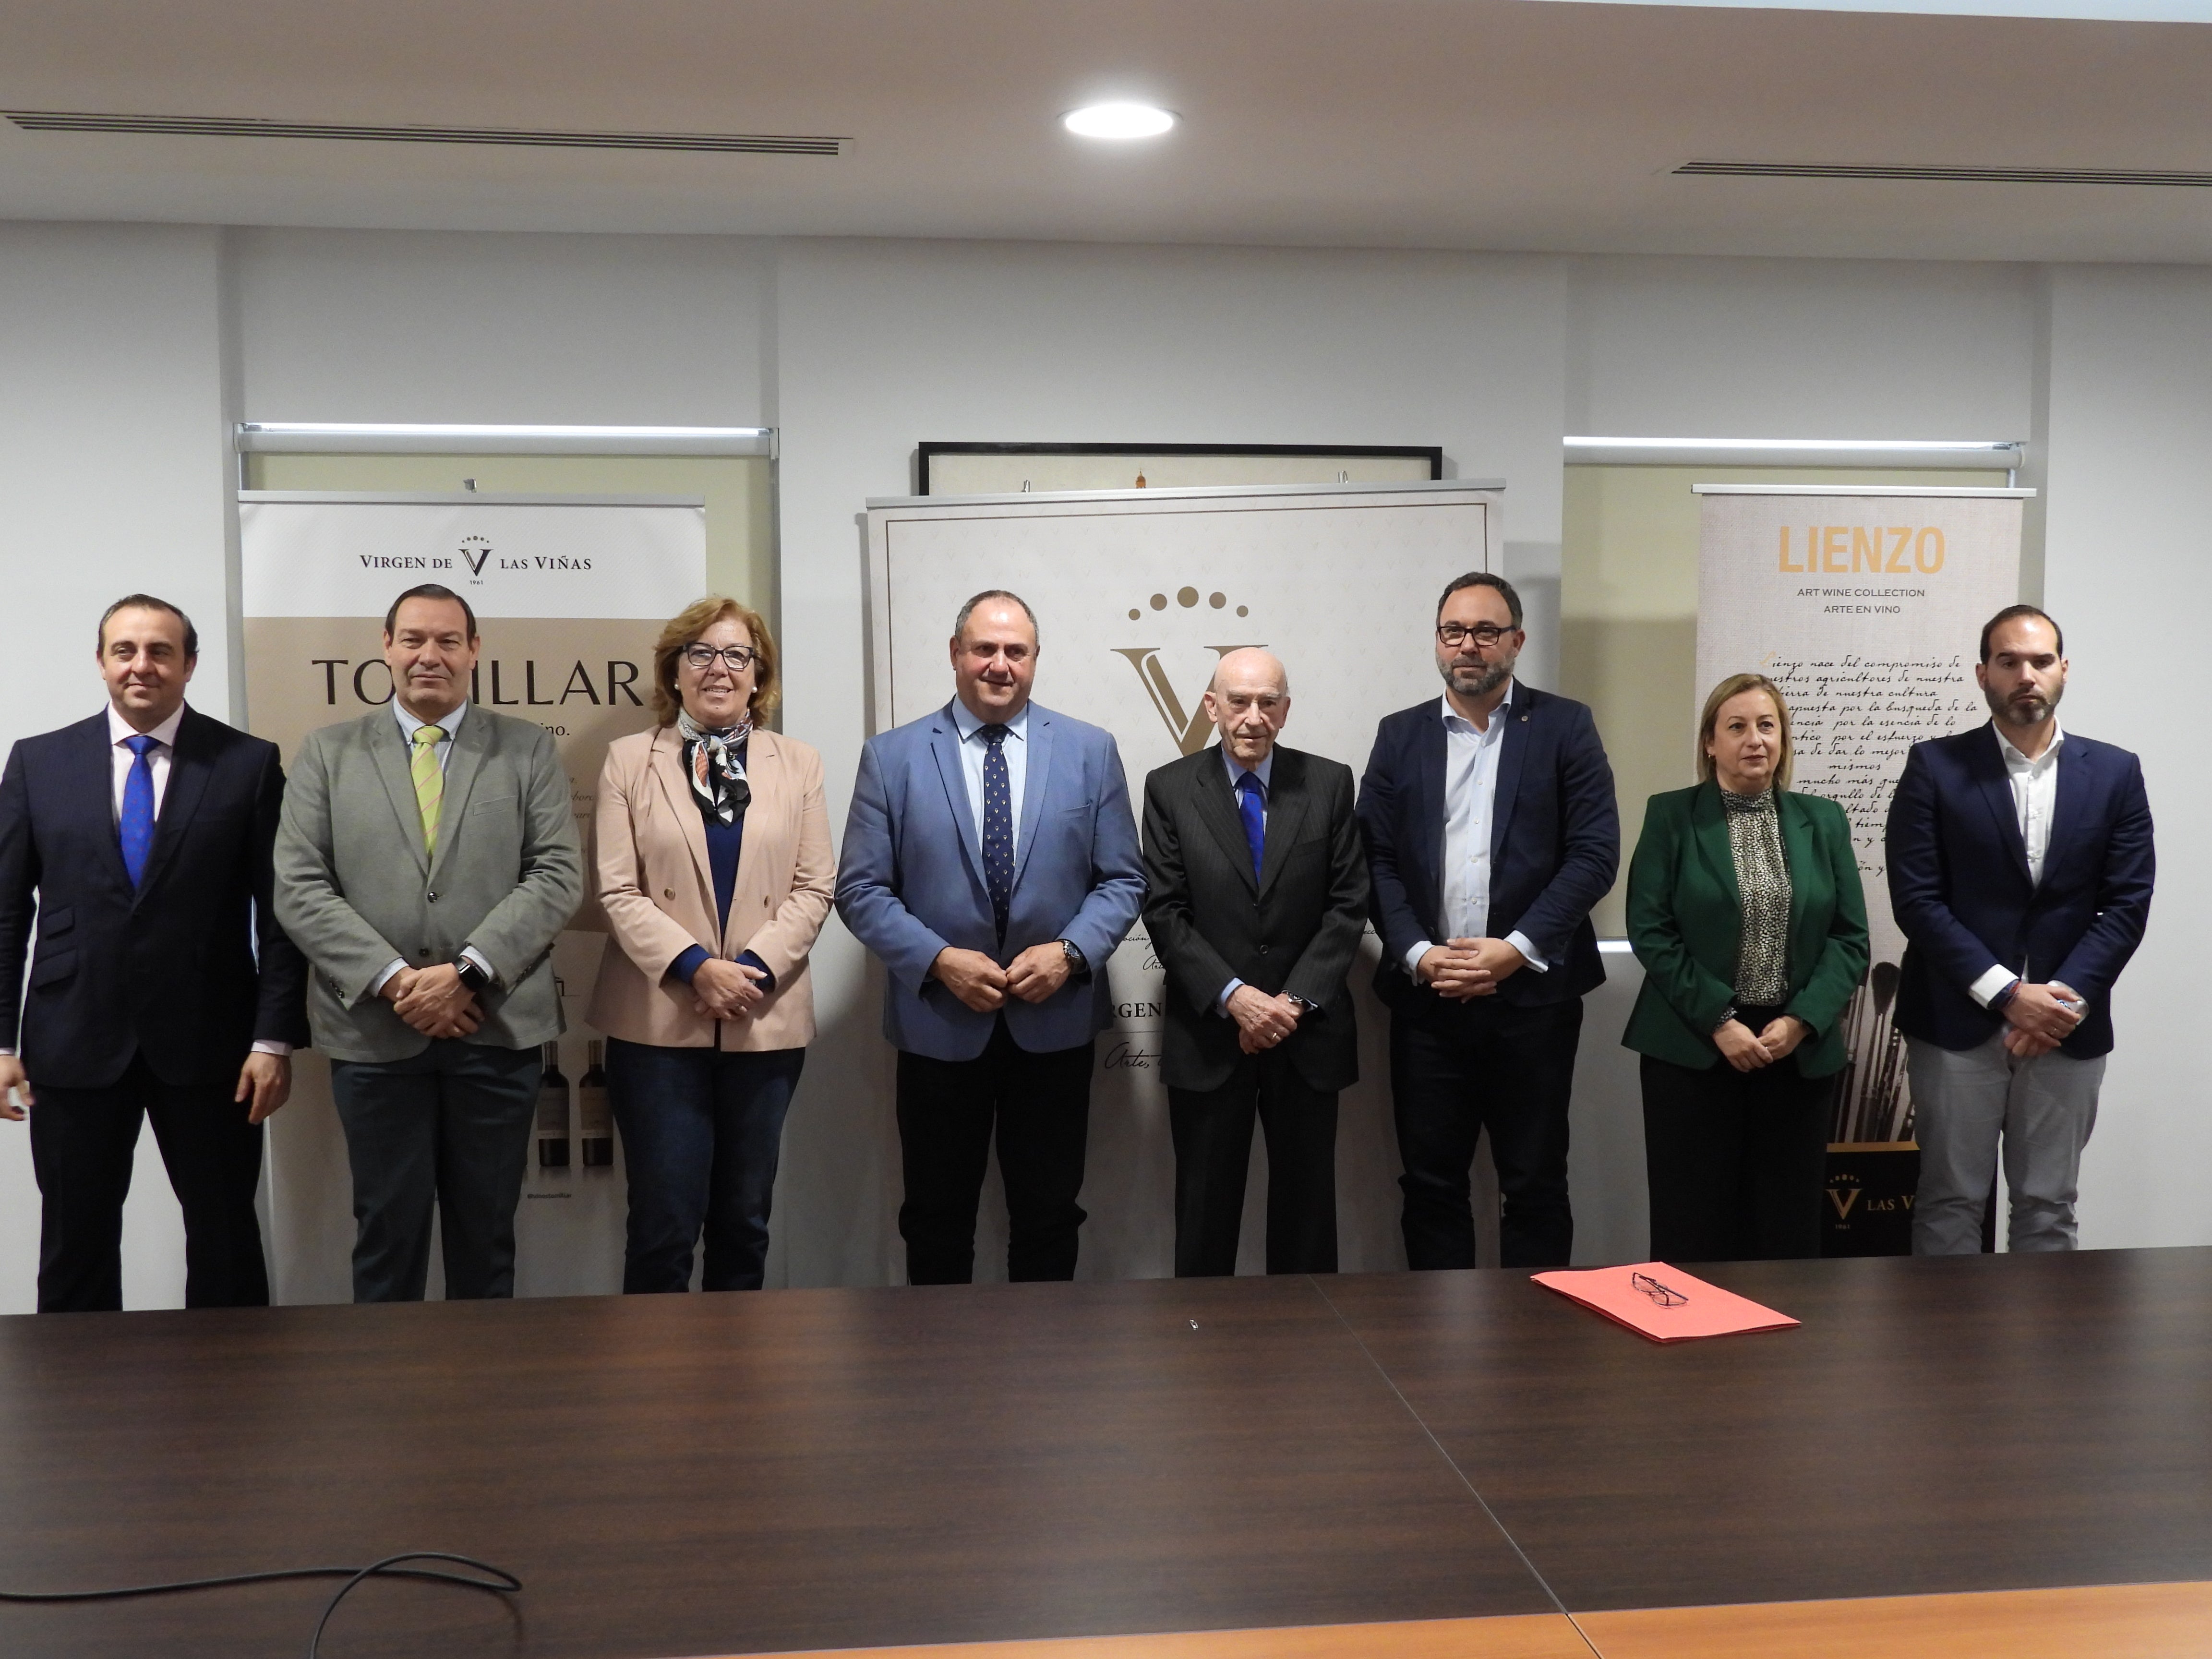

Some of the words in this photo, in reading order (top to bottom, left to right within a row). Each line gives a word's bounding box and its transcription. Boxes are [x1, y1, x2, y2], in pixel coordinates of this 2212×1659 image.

[1779, 526, 1946, 574] LIENZO
[360, 555, 426, 568] VIRGEN
[433, 558, 452, 568] DE
[501, 559, 528, 569] LAS
[535, 555, 591, 570] VIÑAS
[1840, 655, 1861, 667] del
[1864, 657, 1942, 672] compromiso
[1949, 656, 1960, 667] de
[312, 660, 644, 706] TOILLAR
[1770, 673, 1809, 682] estros
[1816, 672, 1890, 685] agricultores
[1898, 670, 1909, 682] de
[1917, 673, 1964, 683] nuestra
[1816, 685, 1828, 696] de
[1836, 687, 1883, 697] nuestra
[1888, 687, 1938, 697] cultura
[1839, 706, 1863, 716] por
[1869, 701, 1881, 711] la
[1948, 699, 1959, 710] de
[1966, 702, 1977, 710] la
[1790, 716, 1823, 726] encia
[1833, 721, 1855, 731] por
[1862, 716, 1874, 725] la
[1880, 716, 1922, 726] esencia
[1927, 714, 1939, 725] de
[1945, 716, 1955, 725] lo
[1792, 730, 1821, 741] ntico
[1831, 735, 1854, 745] por
[1861, 731, 1874, 740] el
[1811, 743, 1823, 755] de
[1829, 743, 1848, 755] dar
[1855, 745, 1865, 755] lo
[1828, 759, 1881, 770] mismos
[1797, 774, 1840, 784] mucho
[1846, 775, 1873, 785] más
[1871, 787, 1882, 798] de
[1846, 801, 1878, 813] ltado
[1113, 1002, 1162, 1018] GEN
[1867, 1199, 1895, 1211] LAS
